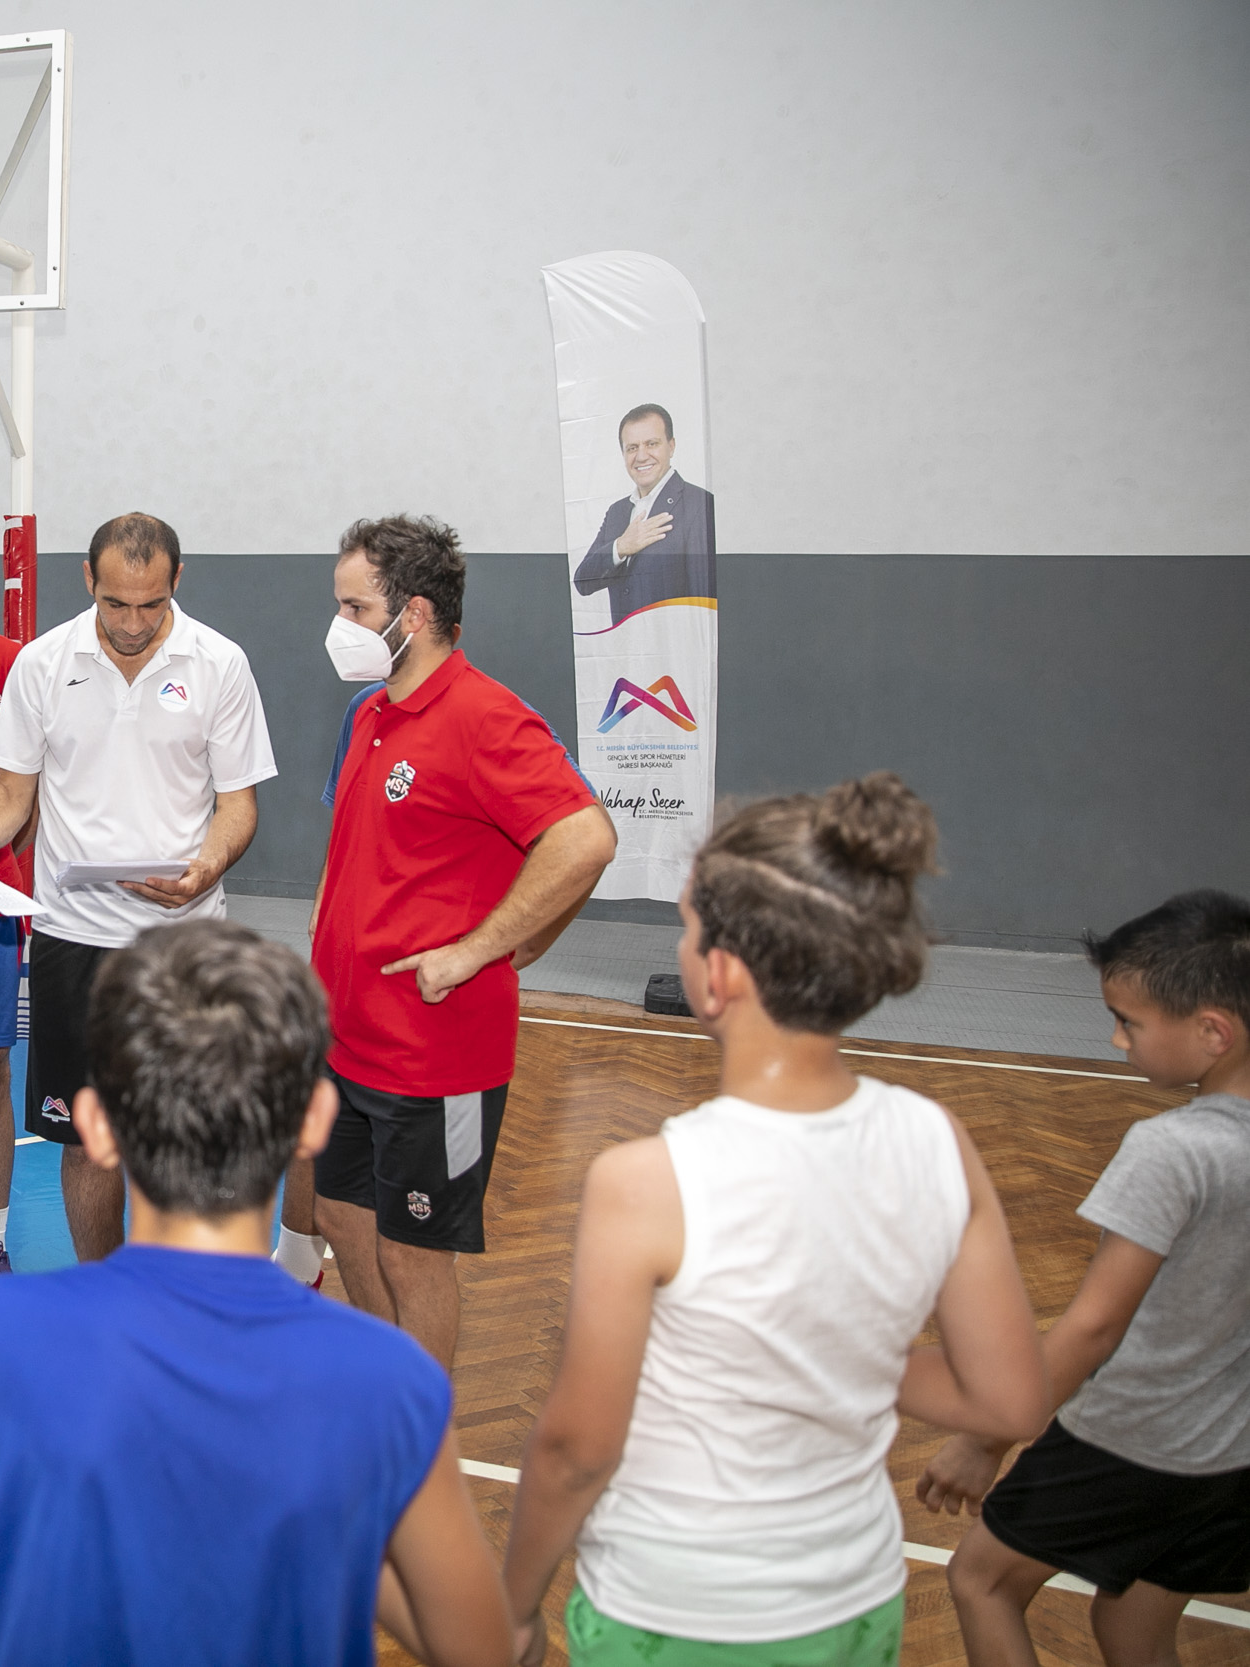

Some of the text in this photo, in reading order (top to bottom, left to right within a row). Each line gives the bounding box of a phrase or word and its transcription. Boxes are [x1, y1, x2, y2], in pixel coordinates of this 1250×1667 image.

[385, 778, 410, 795] MSK
[600, 787, 685, 818] Vahap Seçer
[408, 1203, 432, 1213] MSK
